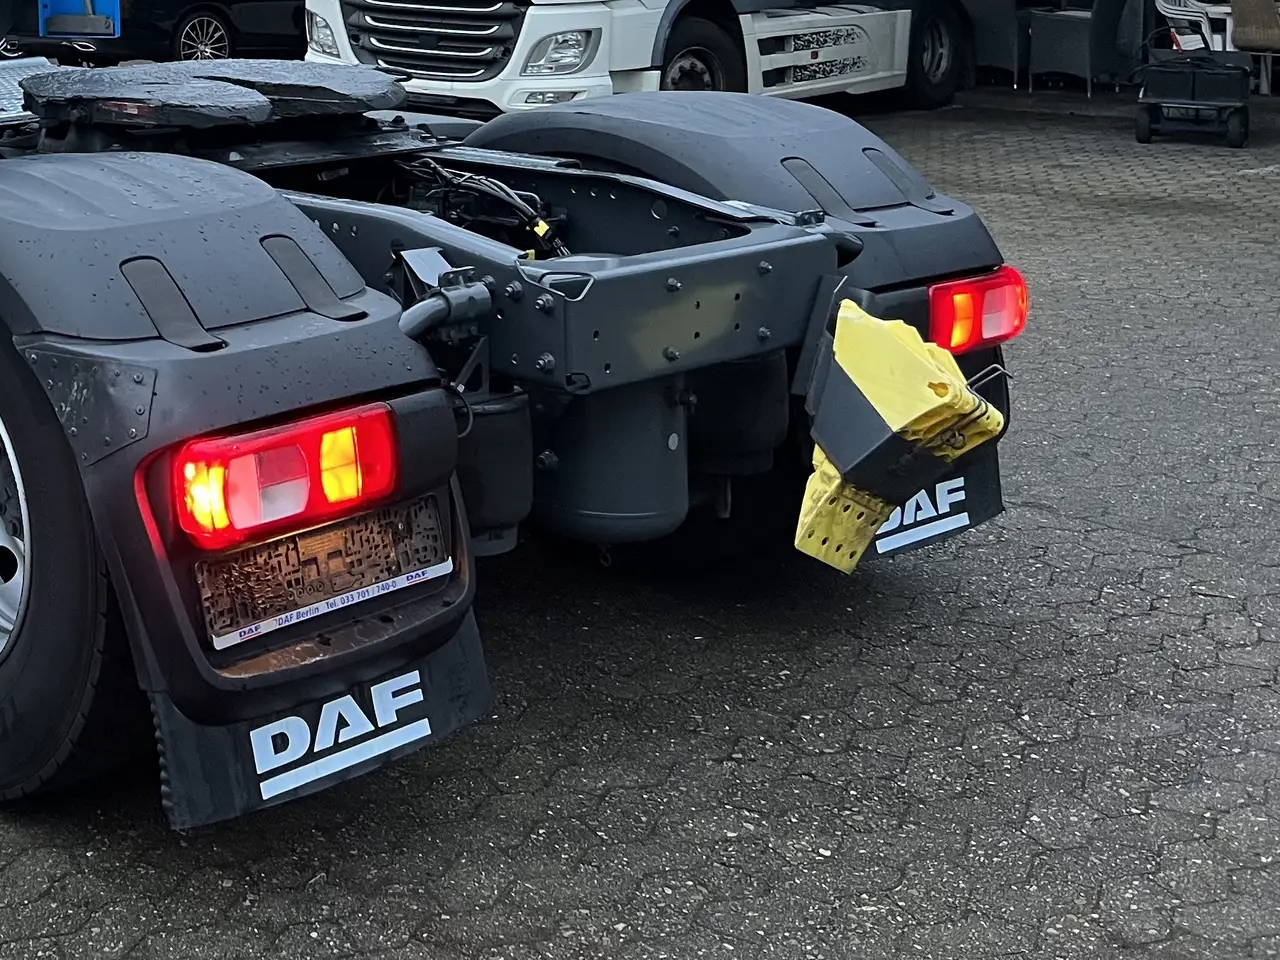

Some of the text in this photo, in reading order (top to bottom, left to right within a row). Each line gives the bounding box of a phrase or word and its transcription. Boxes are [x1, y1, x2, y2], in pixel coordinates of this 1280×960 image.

[238, 625, 262, 638] DAF
[296, 605, 320, 620] Berlin
[324, 600, 340, 611] Tel.
[340, 593, 355, 606] 033
[356, 589, 371, 601] 701
[376, 580, 397, 594] 740-0
[406, 569, 429, 582] DAF
[250, 669, 424, 774] DAF
